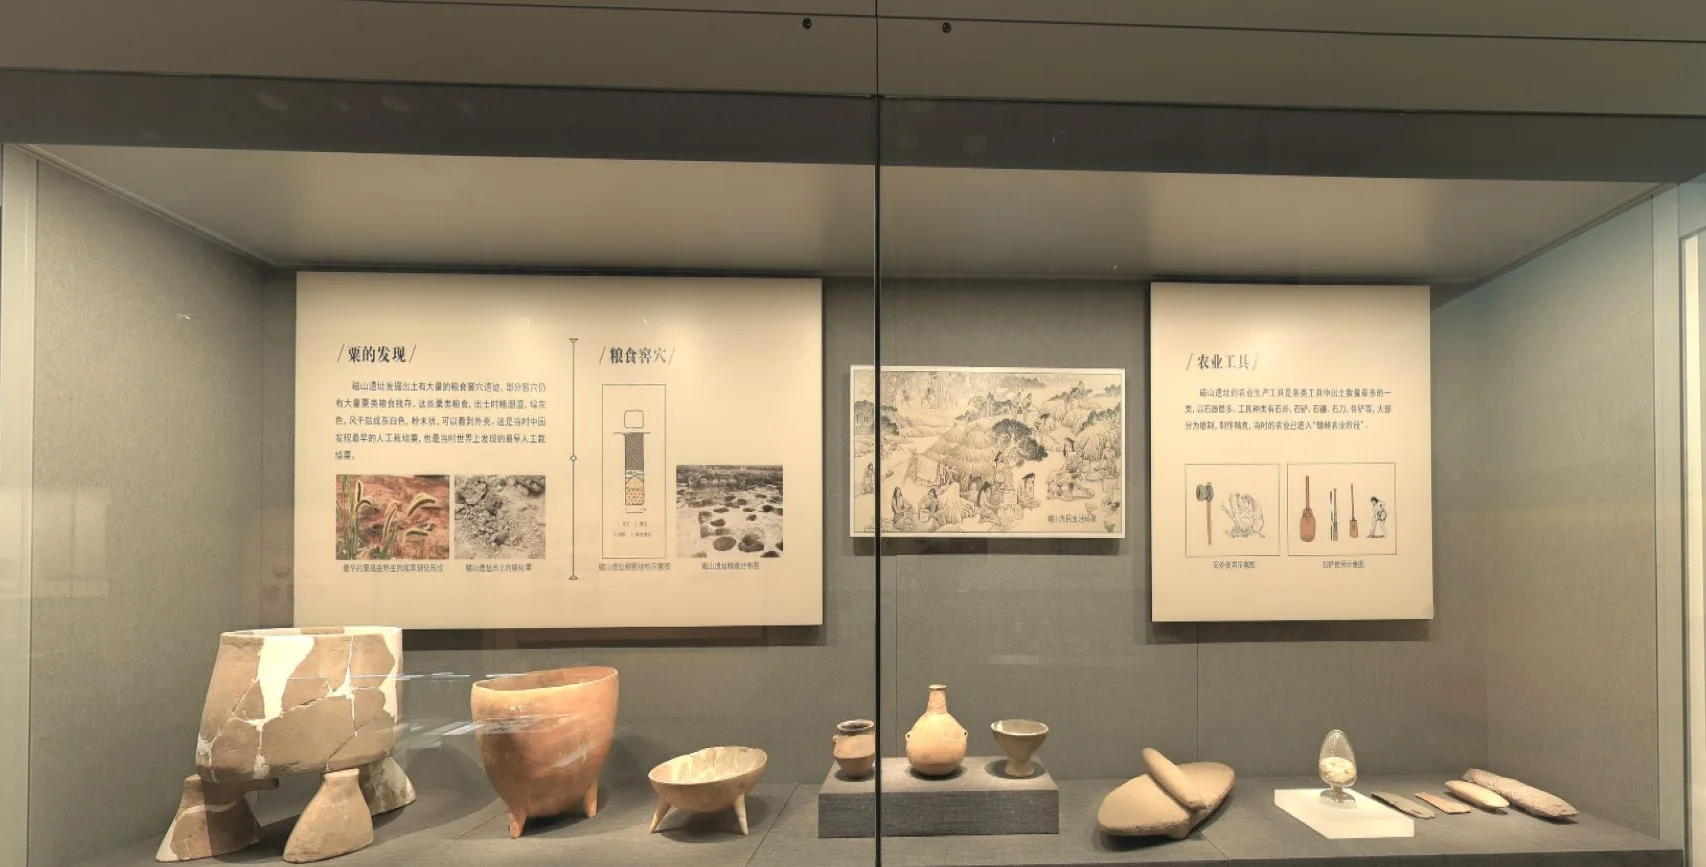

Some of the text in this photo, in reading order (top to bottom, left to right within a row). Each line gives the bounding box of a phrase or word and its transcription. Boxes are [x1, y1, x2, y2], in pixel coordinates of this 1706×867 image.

[348, 346, 406, 363] 粟的发现
[609, 347, 666, 364] 粮食窖穴
[1198, 354, 1249, 369] 农业工具
